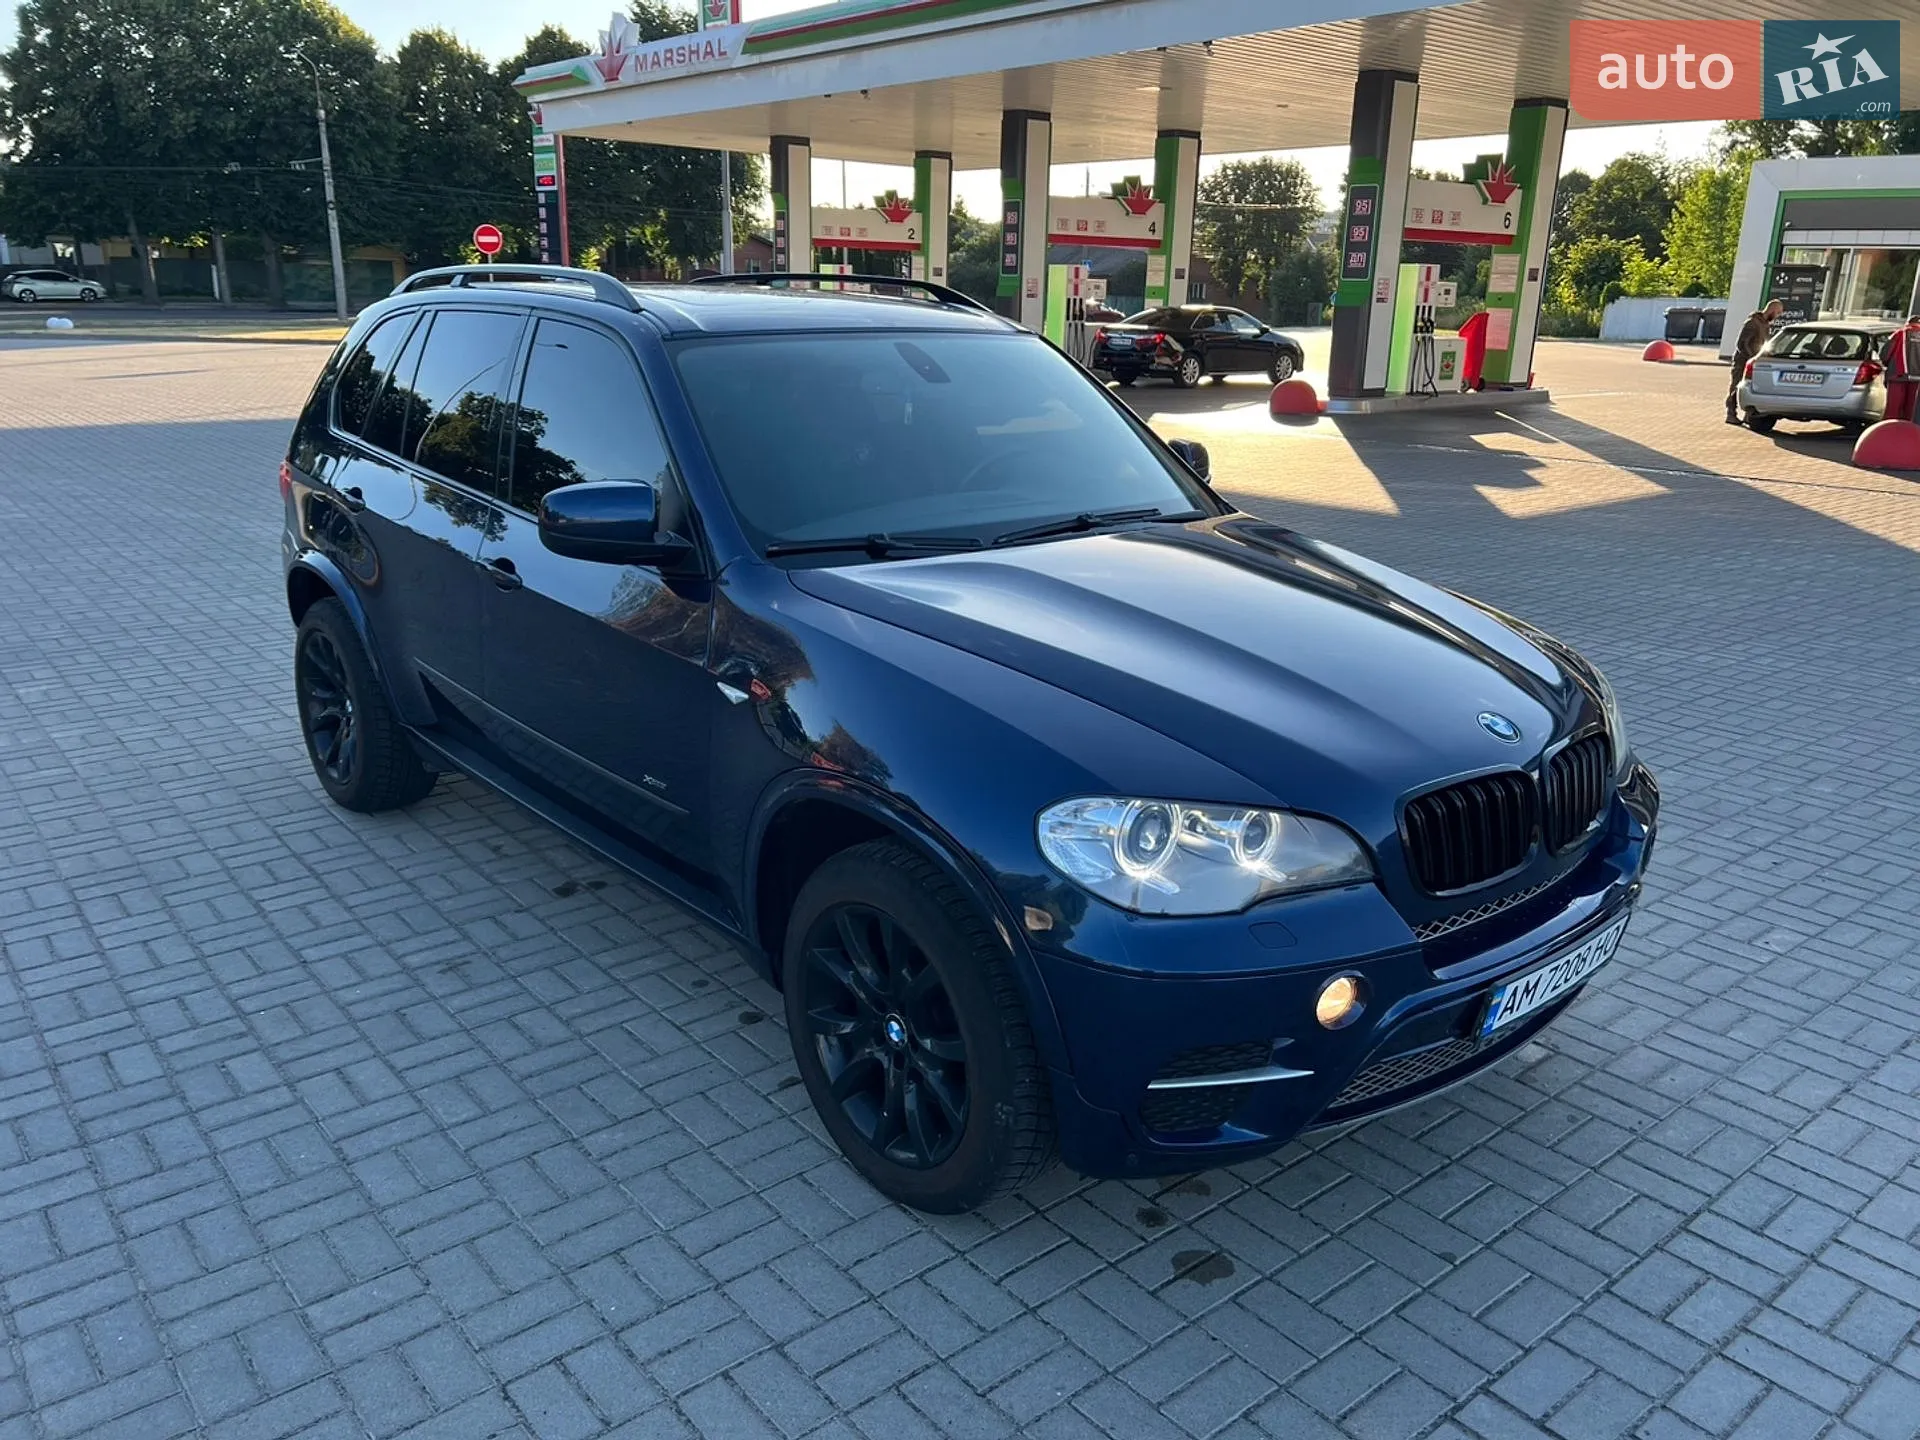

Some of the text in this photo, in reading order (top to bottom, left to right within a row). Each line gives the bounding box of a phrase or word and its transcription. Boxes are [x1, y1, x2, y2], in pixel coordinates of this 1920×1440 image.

[634, 37, 728, 73] MARSHAL
[1148, 221, 1156, 235] 4
[1503, 211, 1512, 230] 6
[907, 227, 915, 240] 2
[1497, 925, 1621, 1022] AM 7208 HO
